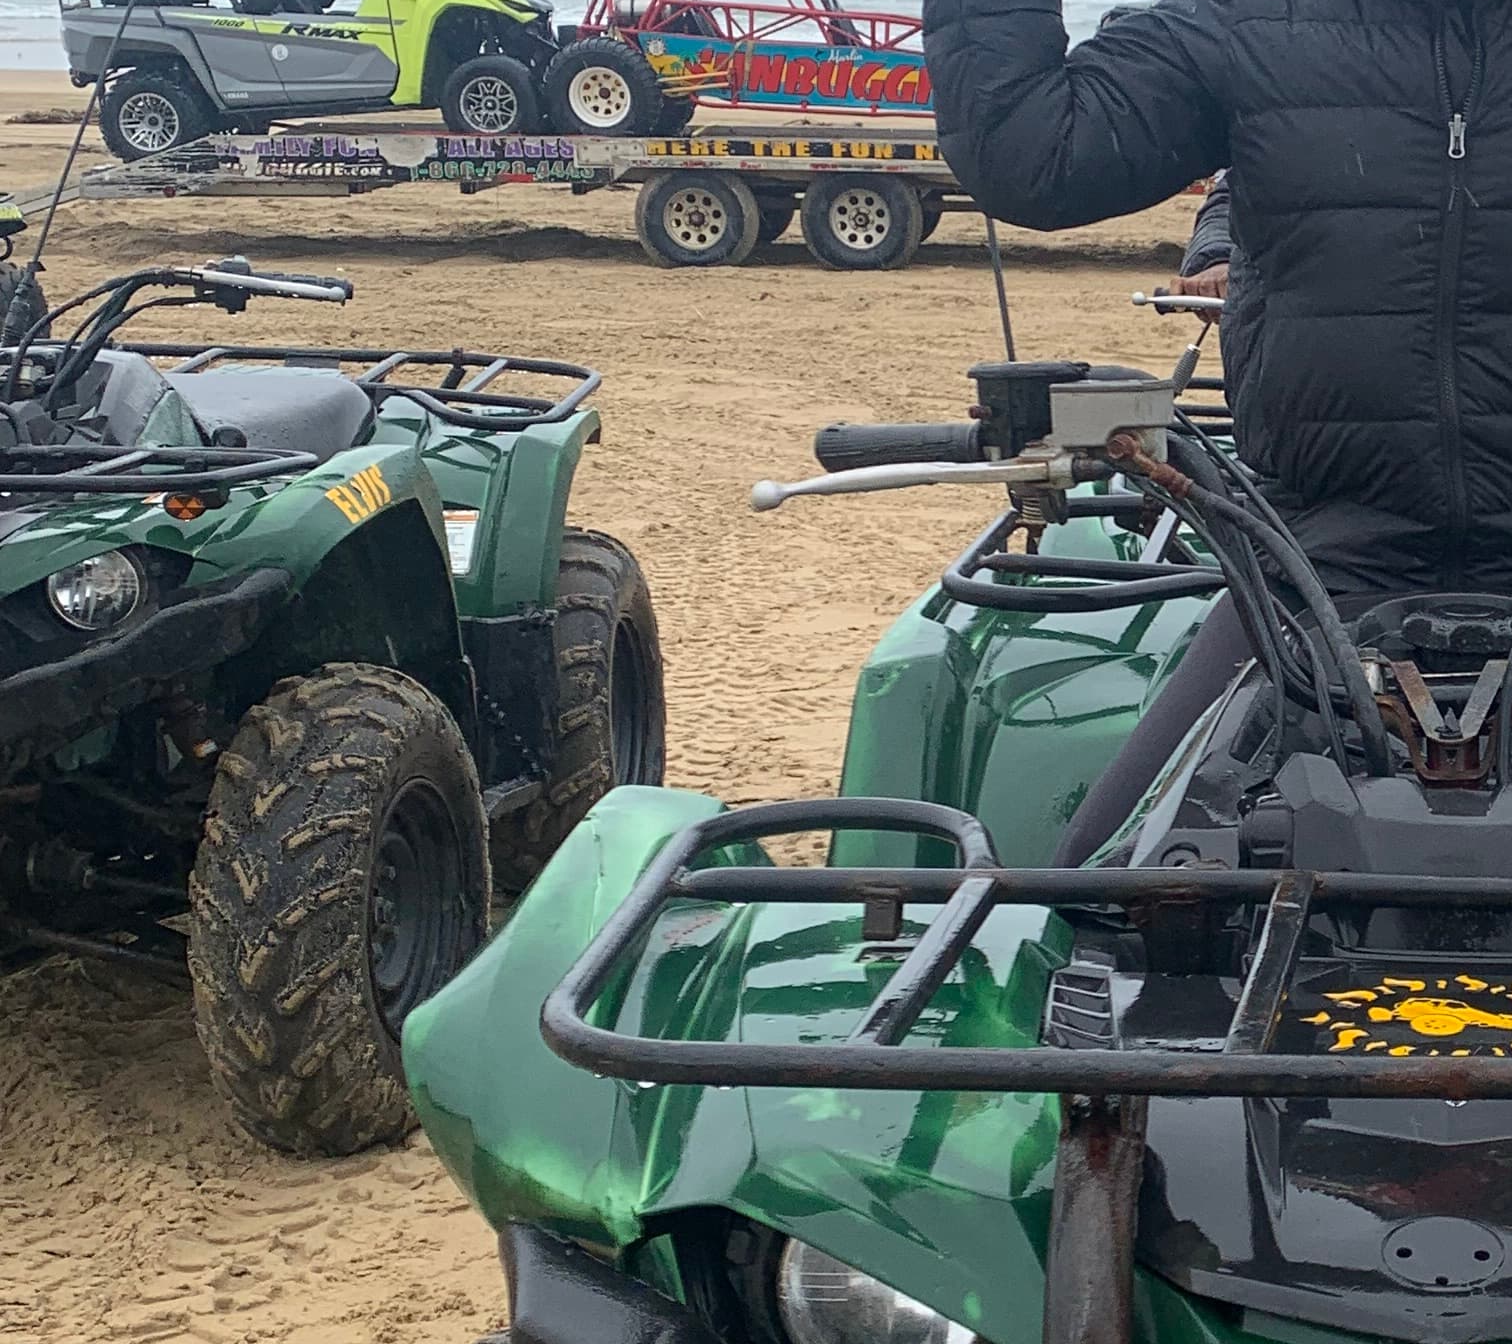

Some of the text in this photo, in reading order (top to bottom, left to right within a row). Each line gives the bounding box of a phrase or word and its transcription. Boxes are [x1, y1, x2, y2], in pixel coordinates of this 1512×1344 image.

[214, 18, 245, 28] 1000
[446, 137, 575, 158] ALL AGES
[754, 141, 812, 157] THE
[830, 143, 894, 159] FUN
[325, 463, 392, 524] ELVIS
